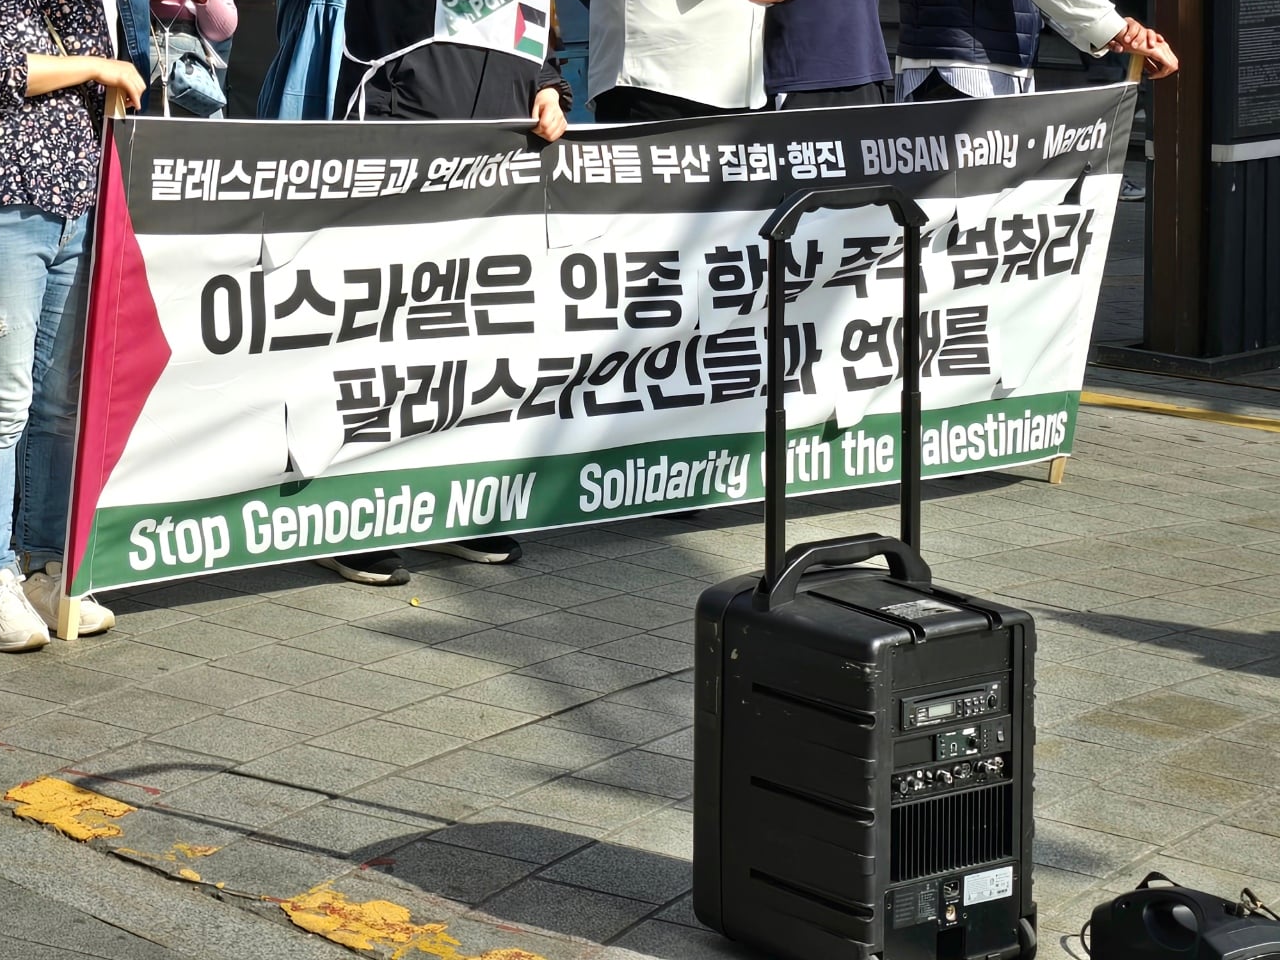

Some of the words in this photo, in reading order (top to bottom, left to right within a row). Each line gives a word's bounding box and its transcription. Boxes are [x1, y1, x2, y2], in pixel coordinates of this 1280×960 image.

[150, 156, 419, 202] 팔레스타인인들과
[419, 147, 542, 193] 연대하는
[552, 142, 643, 185] 사람들
[650, 144, 711, 184] 부산
[716, 139, 847, 182] 집회·행진
[861, 135, 949, 177] BUSAN
[956, 130, 1019, 169] Rally
[1041, 119, 1108, 161] March
[199, 253, 536, 356] 이스라엘은
[559, 249, 685, 332] 인종
[945, 207, 1095, 291] 멈춰라
[332, 321, 823, 444] 팔레스타인인들과
[127, 513, 231, 571] Stop
[240, 484, 437, 557] Genocide
[445, 471, 538, 531] NOW
[578, 448, 750, 514] Solidarity
[760, 437, 832, 488] ith
[840, 429, 896, 475] the
[920, 409, 1068, 469] alestinians
